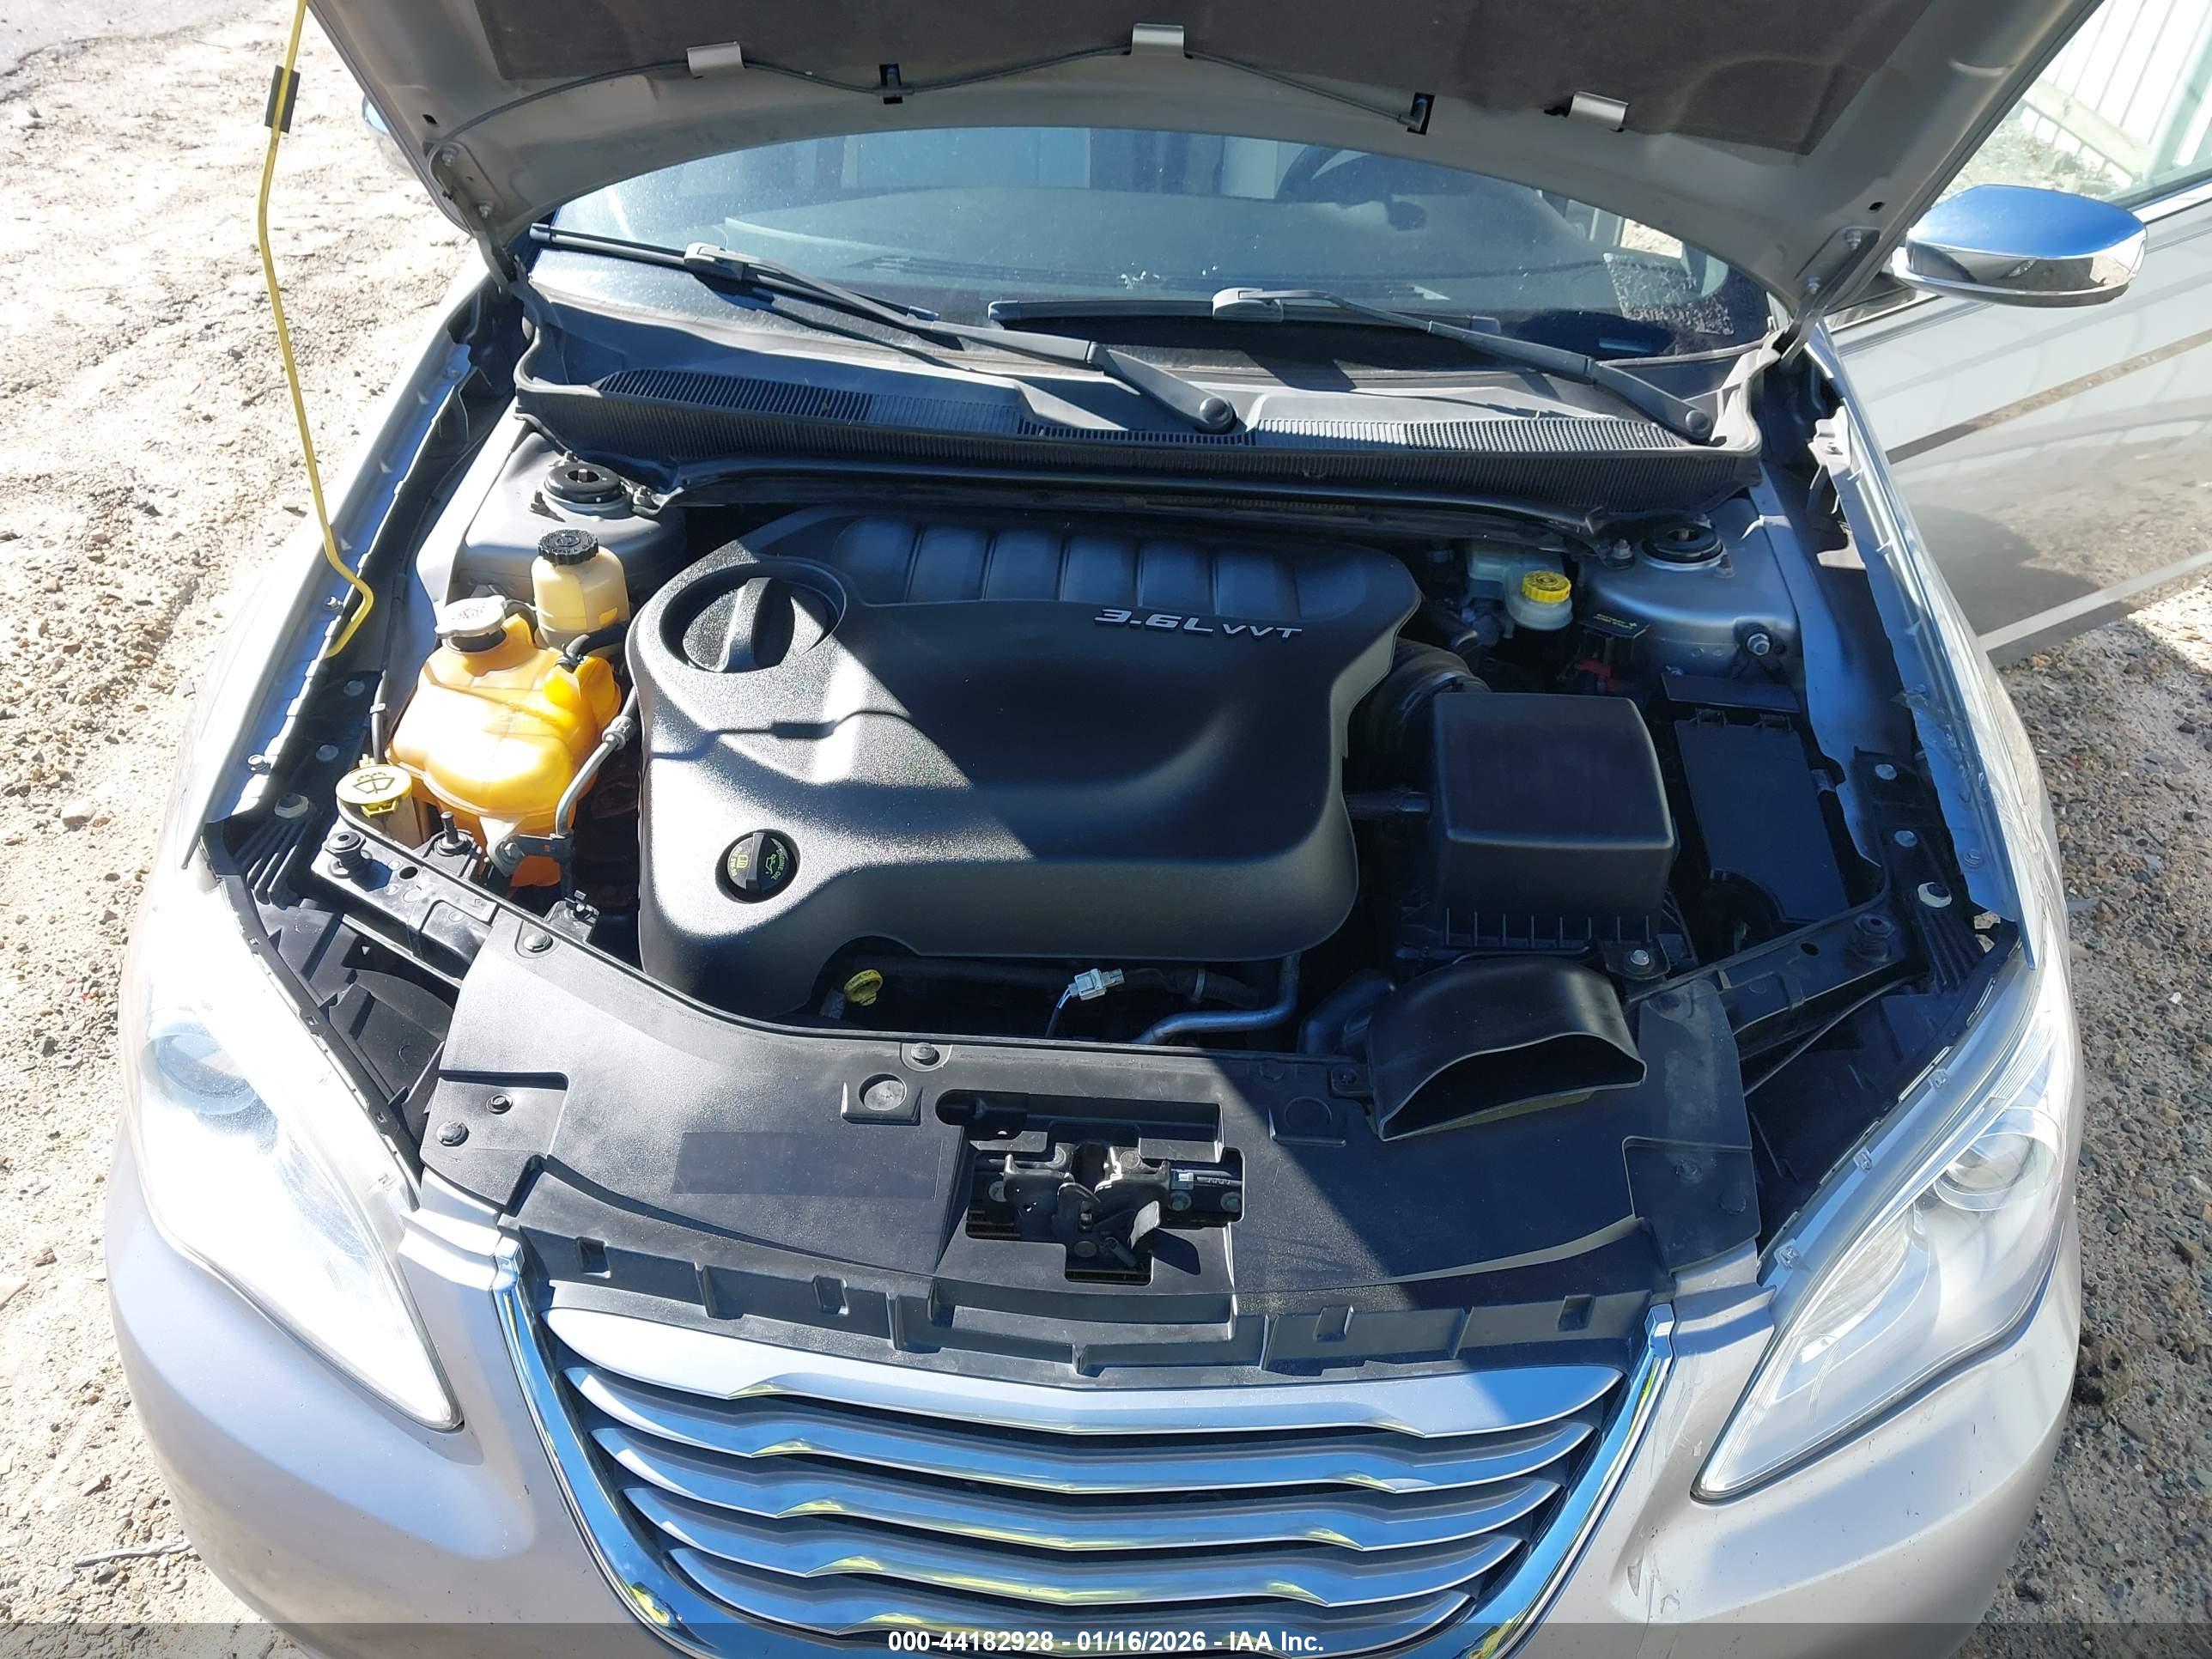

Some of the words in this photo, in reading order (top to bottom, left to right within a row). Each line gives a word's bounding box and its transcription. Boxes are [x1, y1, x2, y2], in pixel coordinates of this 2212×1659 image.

[1094, 608, 1213, 633] 3.6L
[1222, 623, 1303, 639] VVT
[770, 871, 781, 880] OIL
